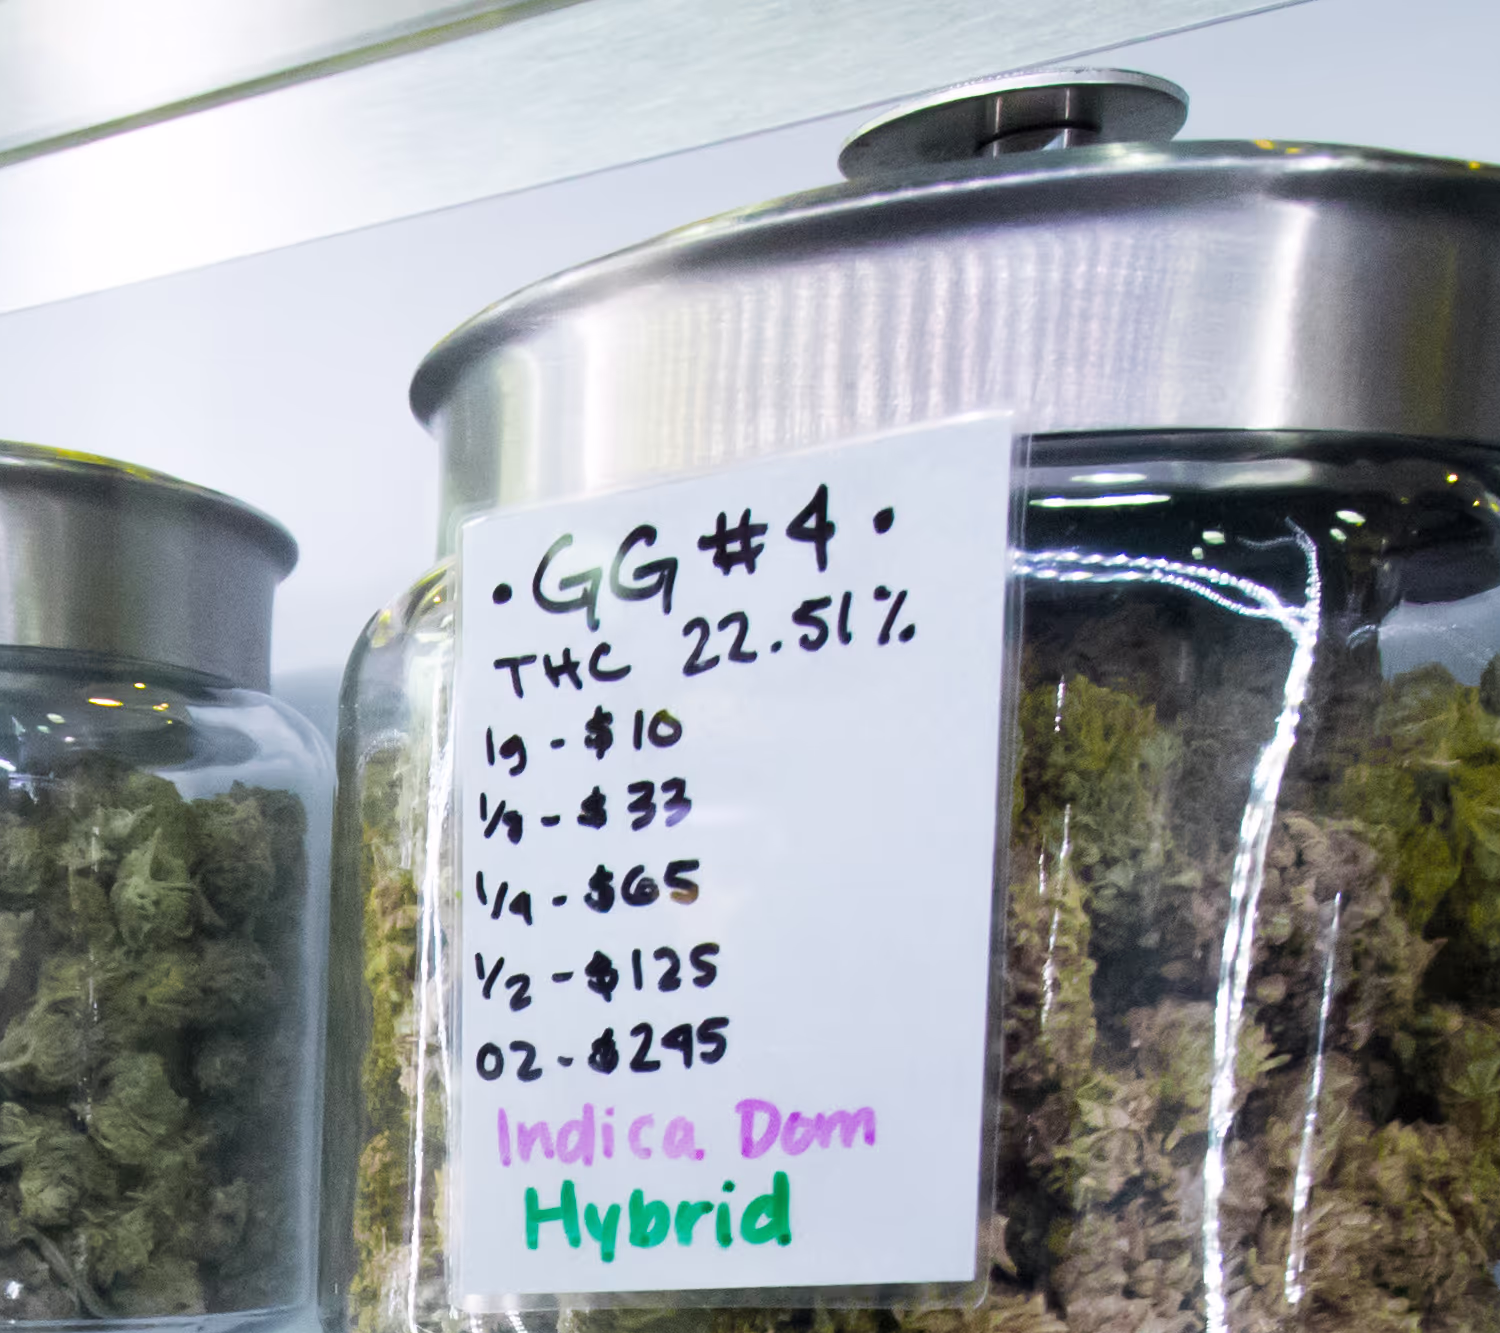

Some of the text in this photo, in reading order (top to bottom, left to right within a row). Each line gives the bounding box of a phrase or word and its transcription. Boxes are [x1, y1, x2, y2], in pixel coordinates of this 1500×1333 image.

[493, 587, 917, 698] THC 22.51%
[496, 1097, 879, 1168] Indica Dom
[523, 1171, 796, 1264] Hybrid
